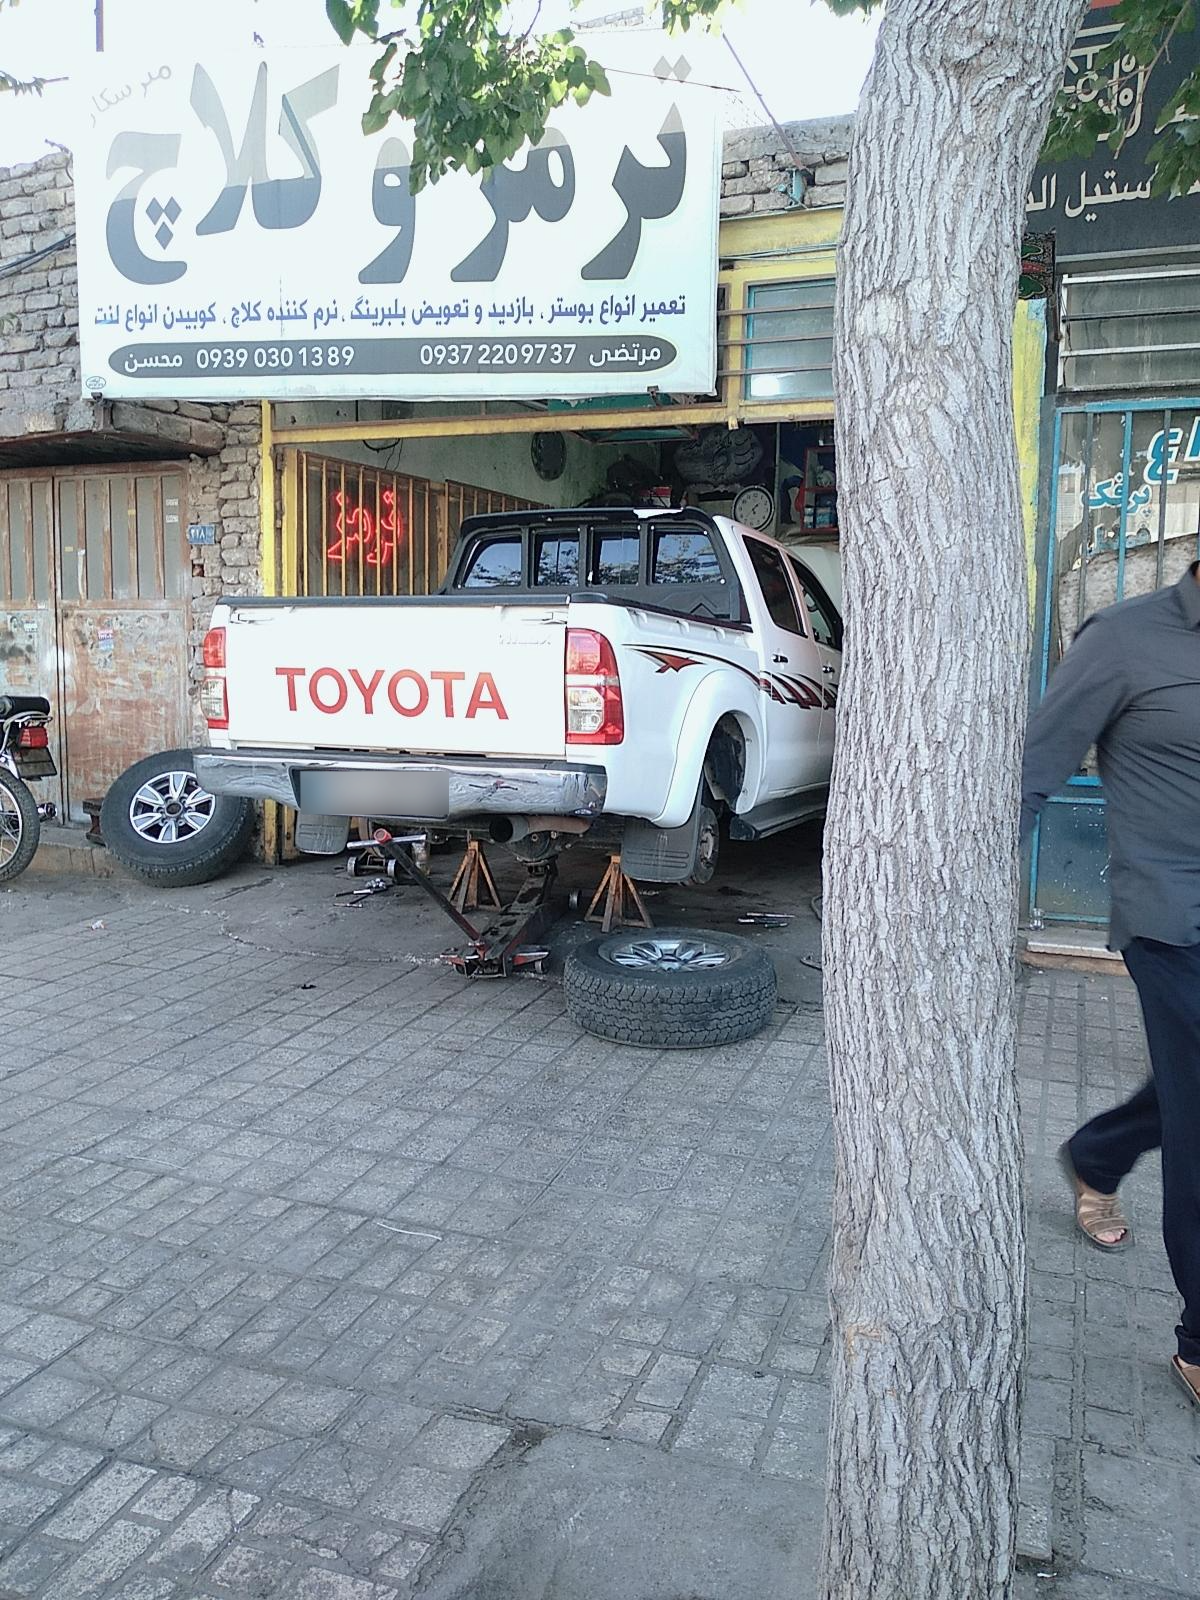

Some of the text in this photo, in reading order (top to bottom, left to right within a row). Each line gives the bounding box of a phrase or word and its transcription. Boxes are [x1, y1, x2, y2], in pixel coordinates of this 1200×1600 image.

[106, 61, 340, 285] کلاچ
[358, 136, 416, 284] و
[95, 304, 119, 324] لنت
[125, 303, 157, 332] انواع
[163, 302, 216, 329] کوبیدن
[267, 298, 308, 320] کننده
[314, 299, 338, 329] نرم
[412, 298, 468, 325] تعویض
[475, 304, 482, 324] و
[488, 296, 534, 325] بازدید
[600, 294, 635, 325] انواع
[640, 294, 686, 323] تعمیر
[124, 353, 183, 372] محسن
[589, 343, 661, 367] مرتضی
[275, 667, 509, 720] TOYOTA
